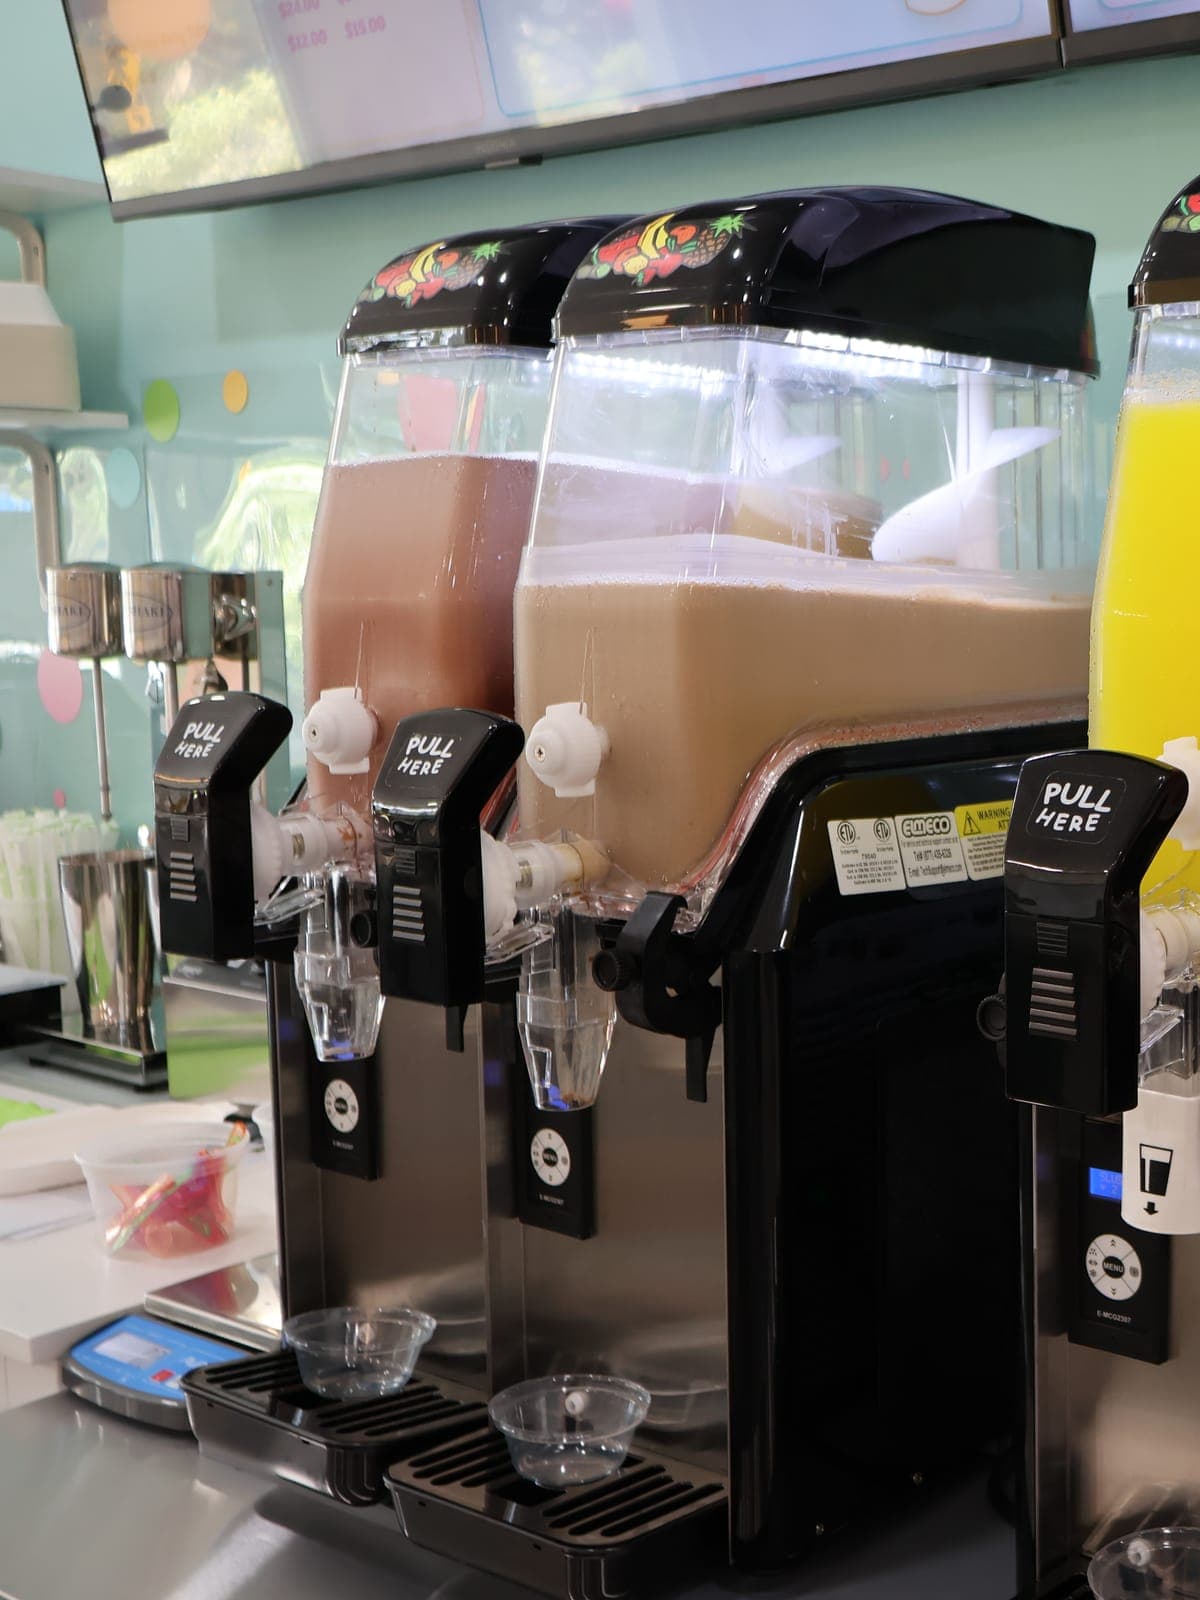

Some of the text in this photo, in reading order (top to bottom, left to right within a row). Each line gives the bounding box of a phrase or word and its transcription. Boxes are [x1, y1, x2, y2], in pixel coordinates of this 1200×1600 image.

[183, 722, 225, 743] PULL
[174, 741, 214, 758] HERE
[405, 735, 455, 759] PULL
[397, 757, 444, 776] HERE
[1043, 782, 1112, 813] PULL
[1035, 807, 1102, 833] HERE
[1103, 1261, 1125, 1273] MENU
